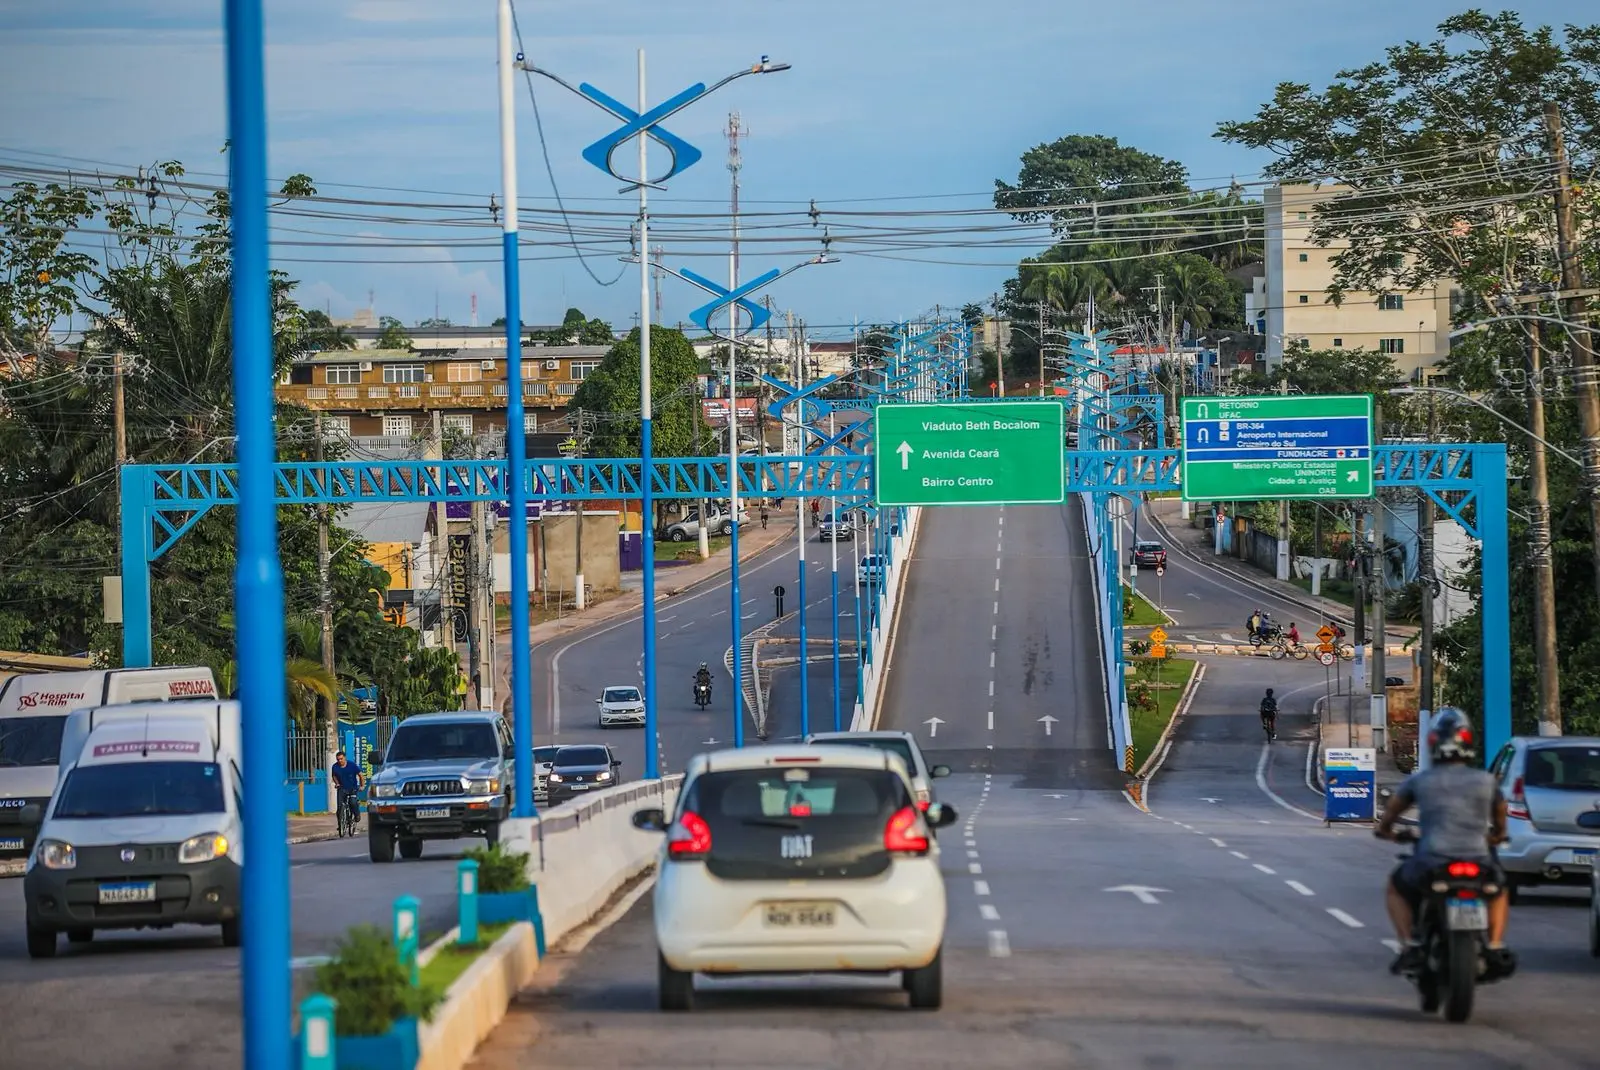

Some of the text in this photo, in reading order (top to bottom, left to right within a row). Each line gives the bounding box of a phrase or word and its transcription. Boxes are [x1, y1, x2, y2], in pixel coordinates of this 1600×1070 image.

[1219, 411, 1242, 419] UFAC
[922, 420, 1040, 431] Viaduto Beth Bocalom
[1236, 422, 1265, 430] BR-364
[1236, 430, 1328, 440] Aeroporto Internacional
[1236, 440, 1270, 448] Cruzeiro
[922, 448, 1000, 459] Avenida Ceará
[1277, 450, 1329, 458] FUNDHACRE
[1303, 461, 1337, 469] Estadual
[1294, 469, 1337, 477] UNINORTE
[922, 476, 994, 487] Bairro Centro
[1268, 477, 1296, 485] Cidade
[1308, 477, 1337, 485] Justiça
[168, 680, 215, 696] NEFROLOGIA
[40, 692, 85, 701] Hospital
